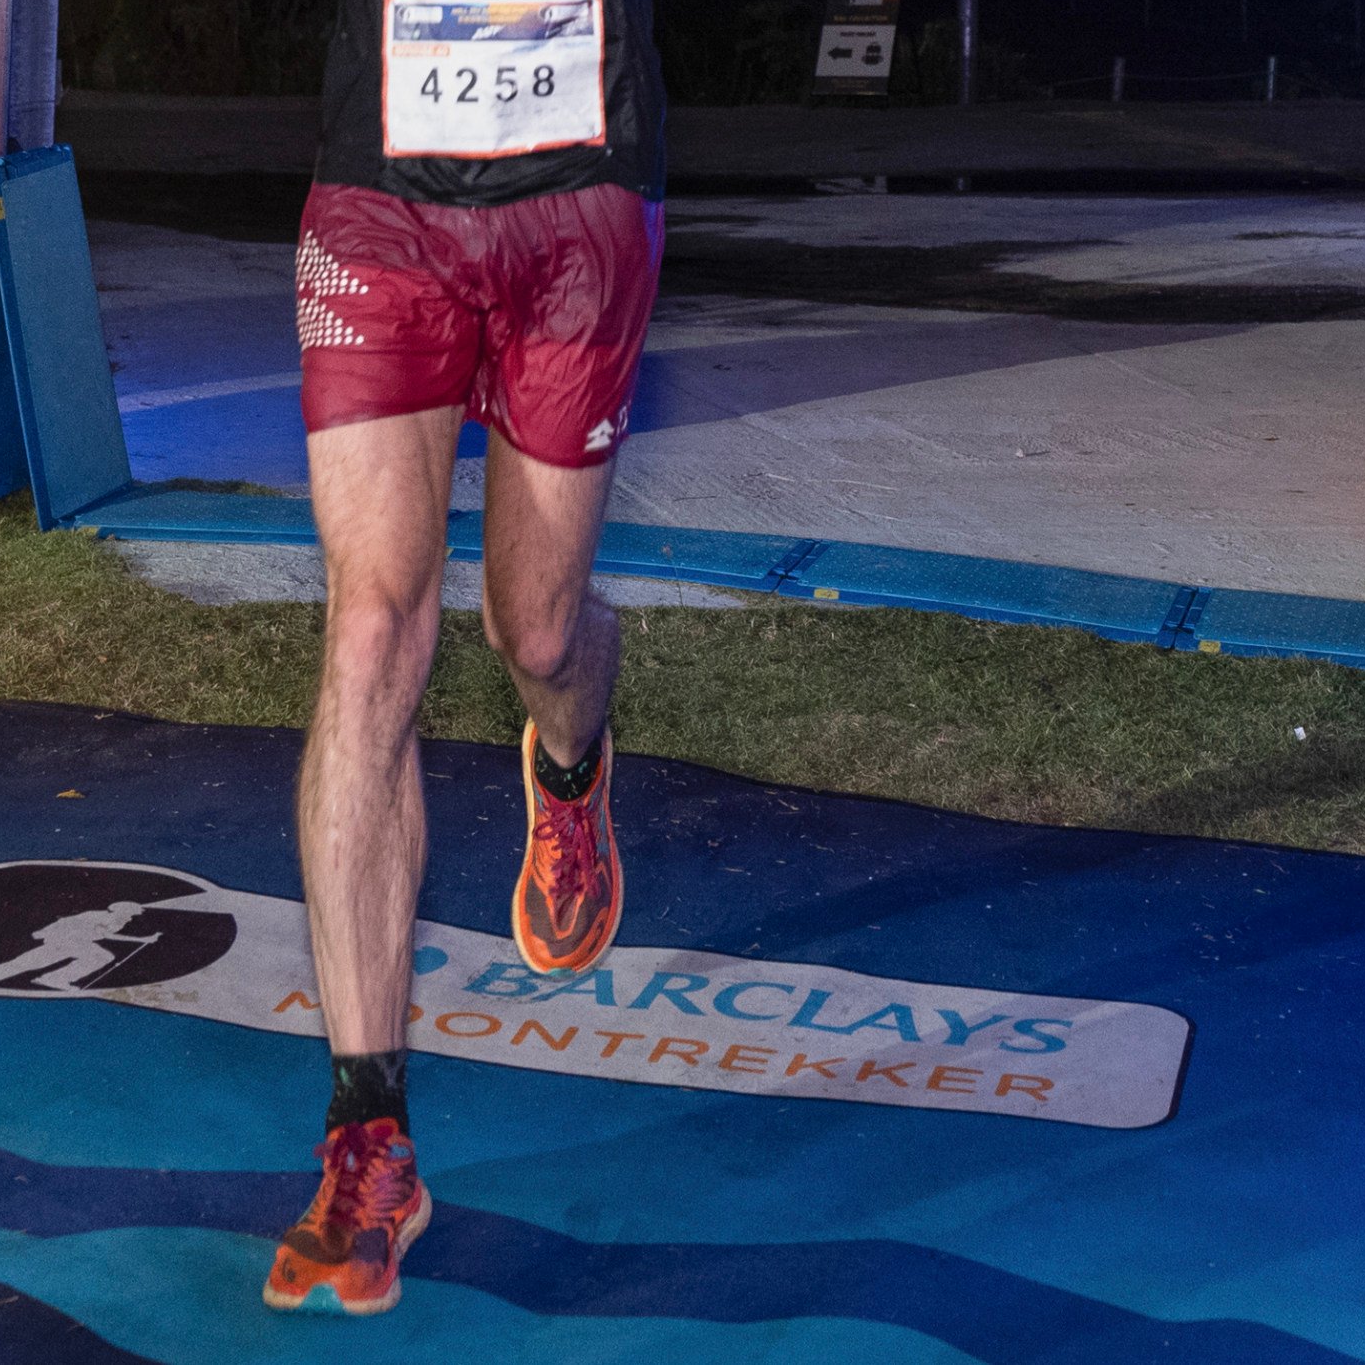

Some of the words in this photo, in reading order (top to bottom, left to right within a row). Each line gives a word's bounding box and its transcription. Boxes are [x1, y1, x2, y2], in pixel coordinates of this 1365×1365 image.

[420, 64, 555, 104] 4258
[272, 991, 1055, 1102] MONTREKKER
[462, 960, 1075, 1055] BARCLAYS
